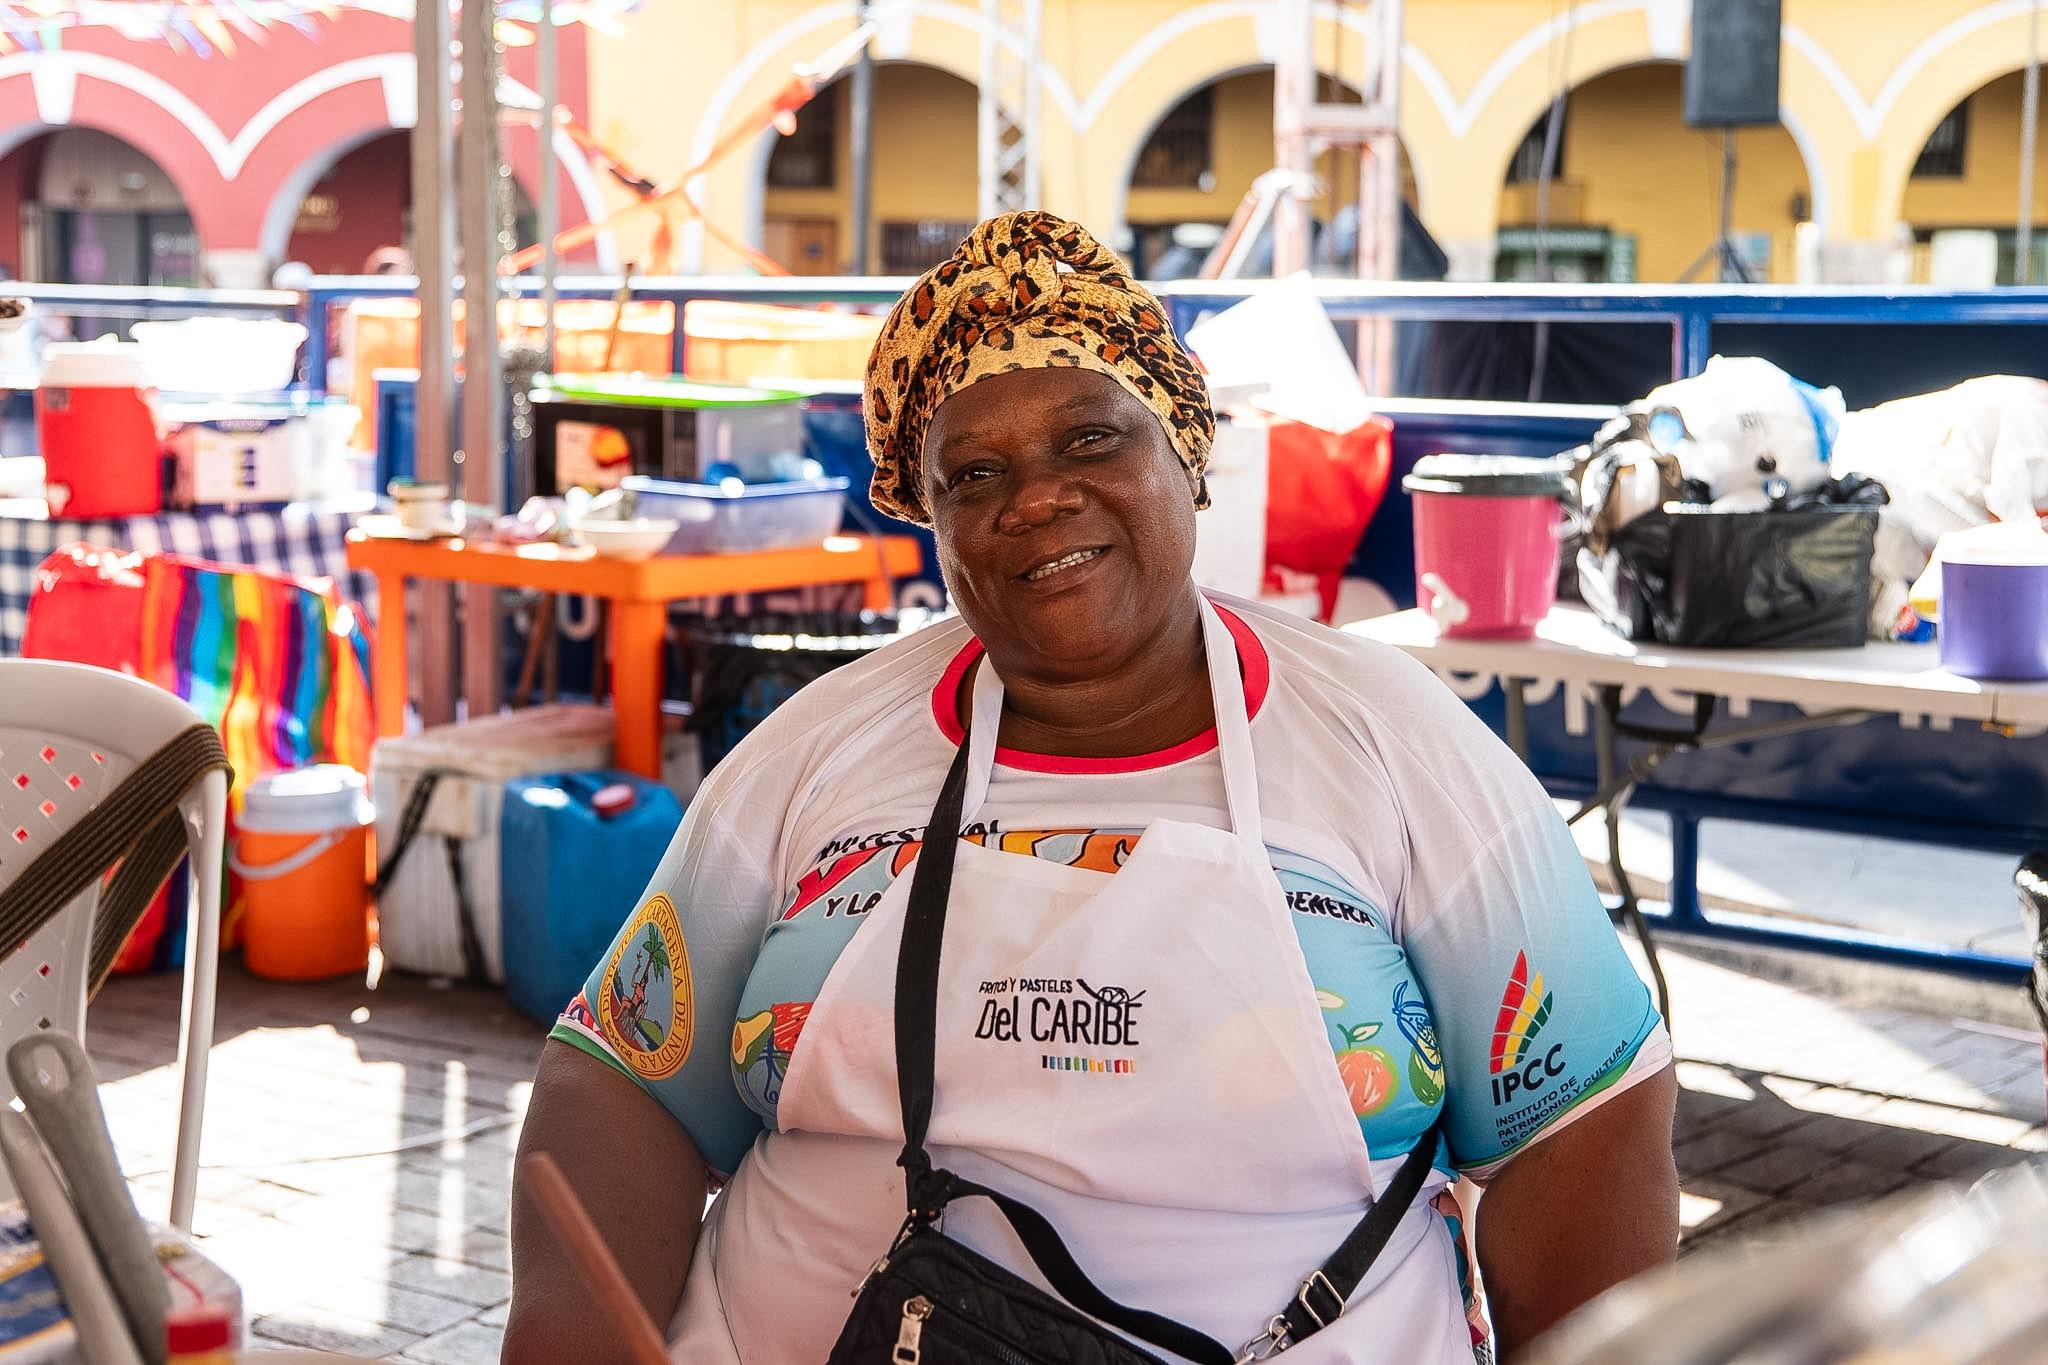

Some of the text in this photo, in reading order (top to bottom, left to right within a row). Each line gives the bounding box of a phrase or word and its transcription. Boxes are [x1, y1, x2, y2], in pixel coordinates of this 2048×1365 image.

[826, 898, 844, 917] Y
[646, 904, 683, 991] CARTAGENA
[602, 931, 632, 1014] DISTRITO
[1009, 977, 1017, 993] Y
[1019, 979, 1073, 994] PASTELES
[674, 1001, 686, 1029] DE
[1031, 997, 1143, 1046] CARIBE
[639, 1033, 683, 1070] INDIAS
[1491, 1043, 1566, 1107] IPCC
[1495, 1075, 1578, 1128] INSTITUTO DE
[1497, 1039, 1629, 1139] PATRIMONIO Y CULTURA
[1501, 1137, 1518, 1148] DE
